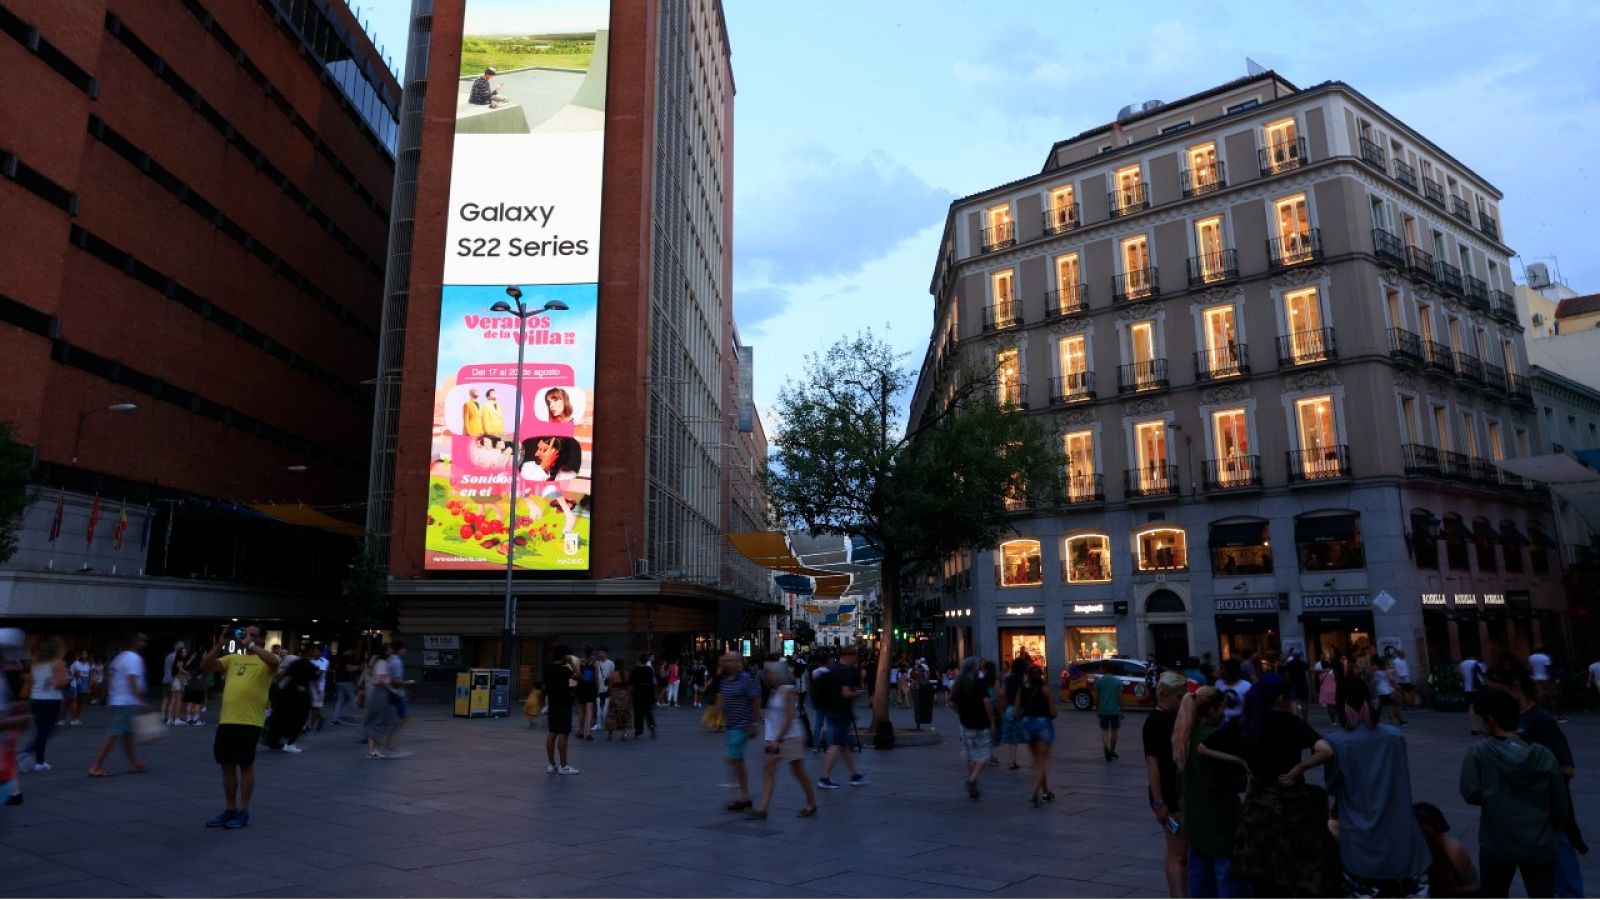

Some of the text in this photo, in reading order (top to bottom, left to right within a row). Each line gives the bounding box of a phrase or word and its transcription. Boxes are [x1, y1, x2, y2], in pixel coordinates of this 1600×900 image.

[459, 202, 555, 228] Galaxy
[457, 234, 590, 257] S22 Series
[484, 330, 498, 339] de
[500, 330, 511, 339] la
[472, 368, 561, 379] Del 17 al 20 de agosto
[460, 486, 492, 497] en el
[1216, 599, 1274, 610] RODILLA
[1305, 595, 1369, 607] RODILLA
